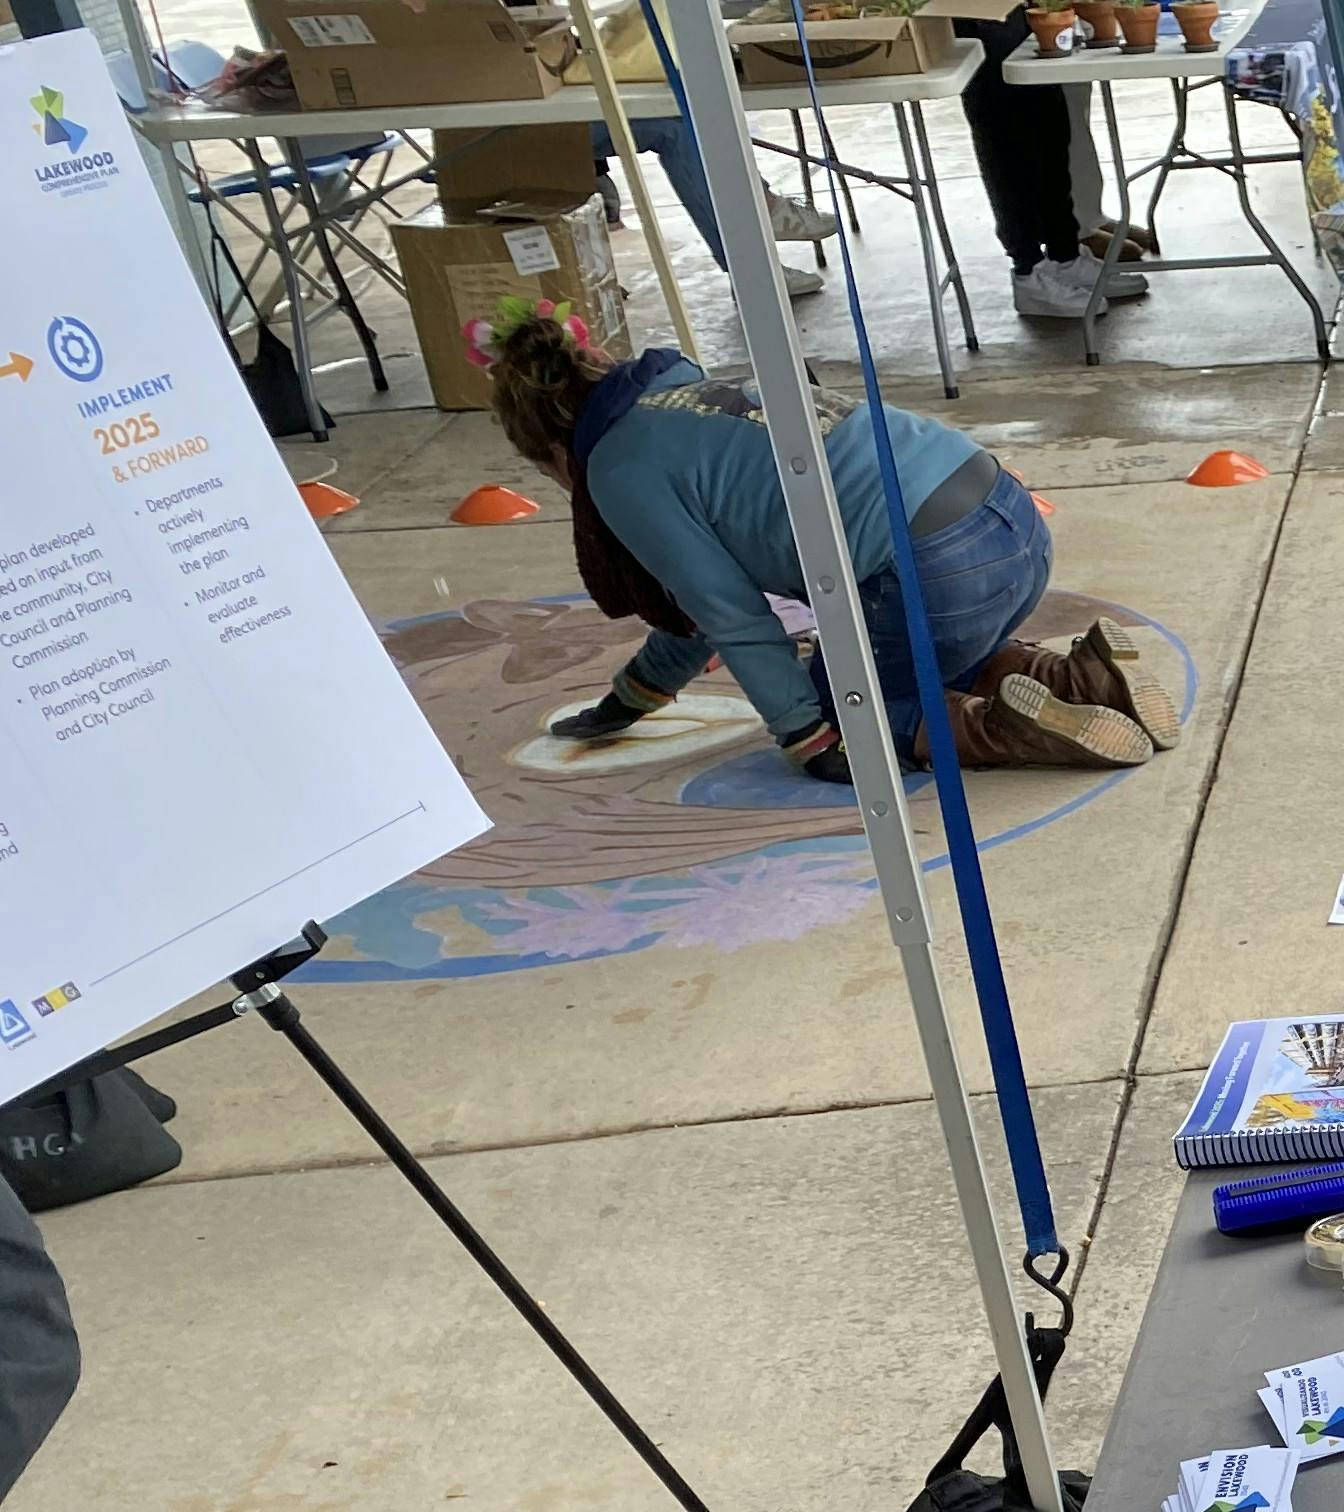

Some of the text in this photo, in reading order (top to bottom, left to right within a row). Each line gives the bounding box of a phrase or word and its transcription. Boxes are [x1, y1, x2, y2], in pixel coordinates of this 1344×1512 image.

[35, 152, 114, 182] LAKEWOOD
[77, 374, 174, 419] IMPLEMENT
[93, 412, 161, 455] 2025
[111, 436, 210, 484] & FORWARD
[145, 476, 224, 514] Departments
[28, 522, 96, 560] developed
[158, 508, 205, 535] actively
[168, 515, 250, 555] implementing
[18, 570, 36, 590] on
[36, 557, 73, 584] input
[71, 549, 105, 570] from
[85, 568, 114, 588] City
[179, 549, 230, 576] the plan
[194, 564, 266, 605] Monitor and
[0, 587, 134, 649] Council and Planning
[207, 594, 259, 624] evaluate
[218, 605, 293, 644] effectiveness
[11, 630, 90, 671] Commission
[28, 647, 138, 702] Plan adoption by
[41, 657, 173, 722] Planning Commission
[55, 688, 156, 743] and City Council
[1215, 1454, 1238, 1499] ENVISION
